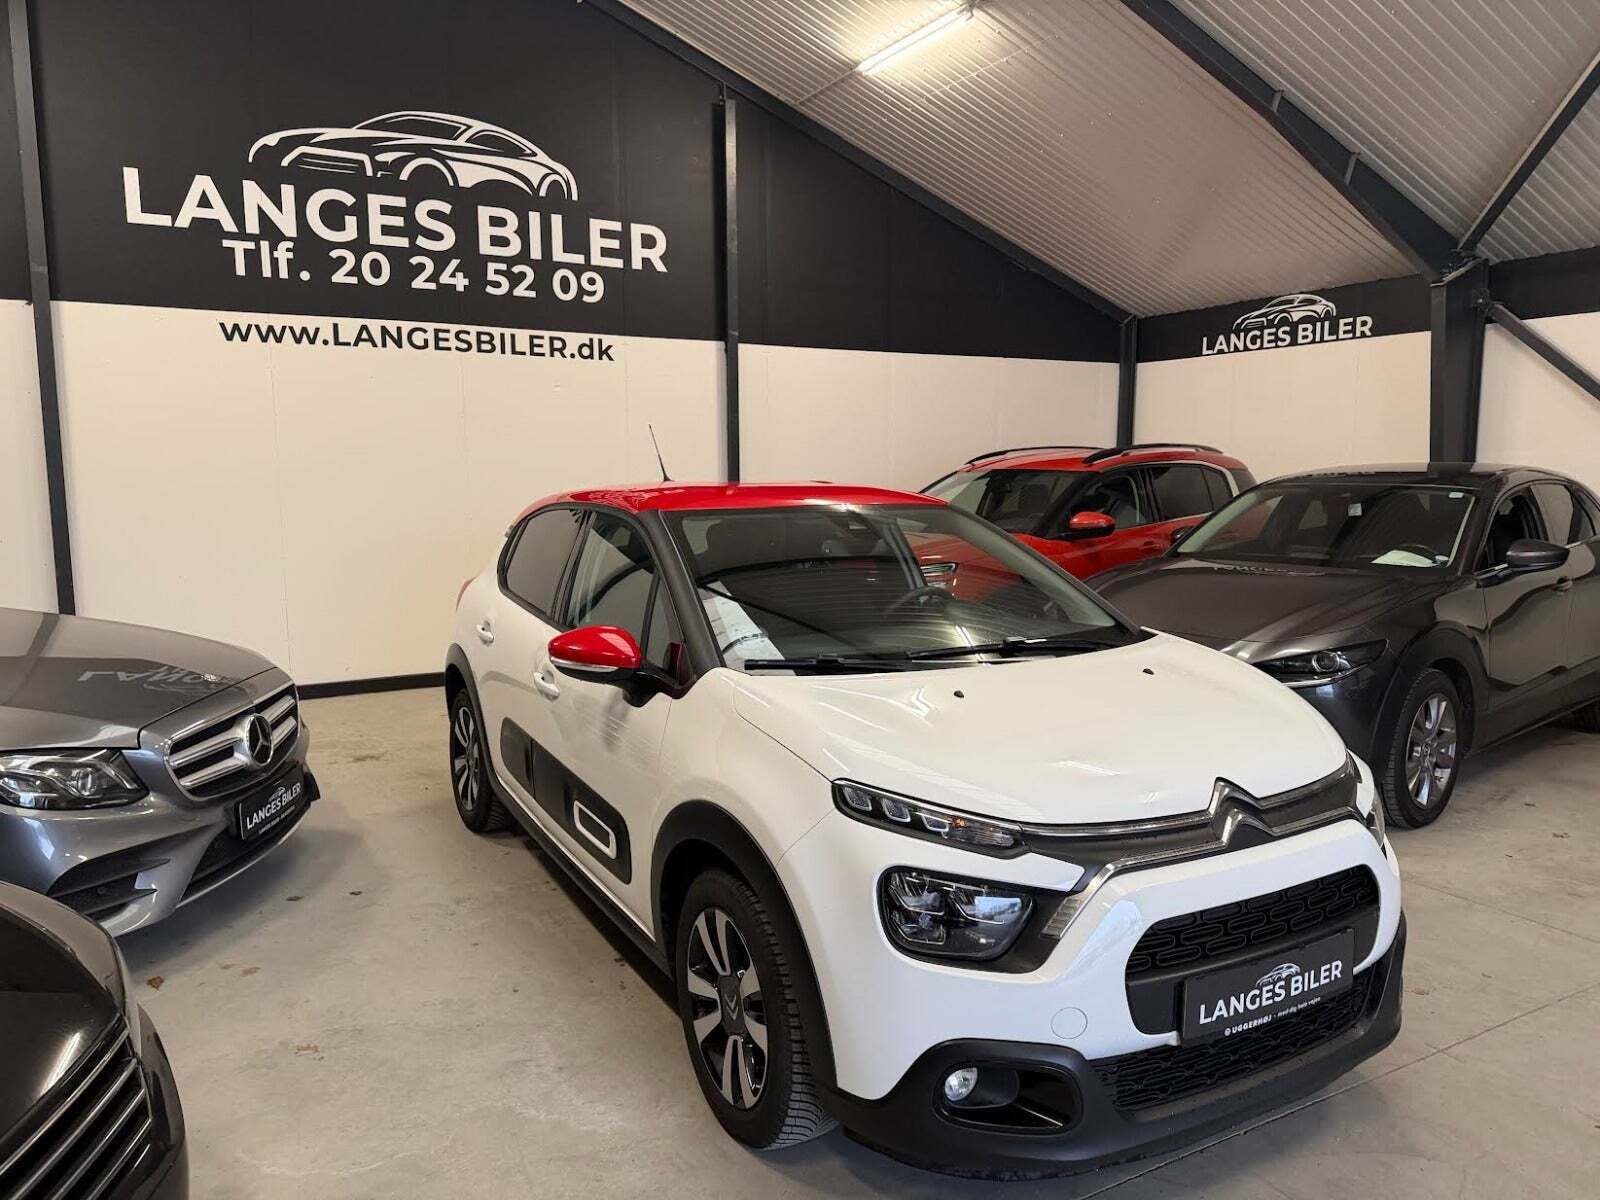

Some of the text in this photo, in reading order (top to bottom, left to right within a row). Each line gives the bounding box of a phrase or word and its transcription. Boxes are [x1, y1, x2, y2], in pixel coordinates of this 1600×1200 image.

[123, 167, 668, 272] LANGES BILER
[222, 239, 605, 303] Tlf. 20 24 52 09
[219, 321, 615, 361] www.LANGESBILER.dk
[1202, 315, 1373, 355] LANGES BILER
[246, 798, 281, 829] LANGES
[282, 783, 301, 806] BILER
[1199, 960, 1342, 1024] LANGES BILER
